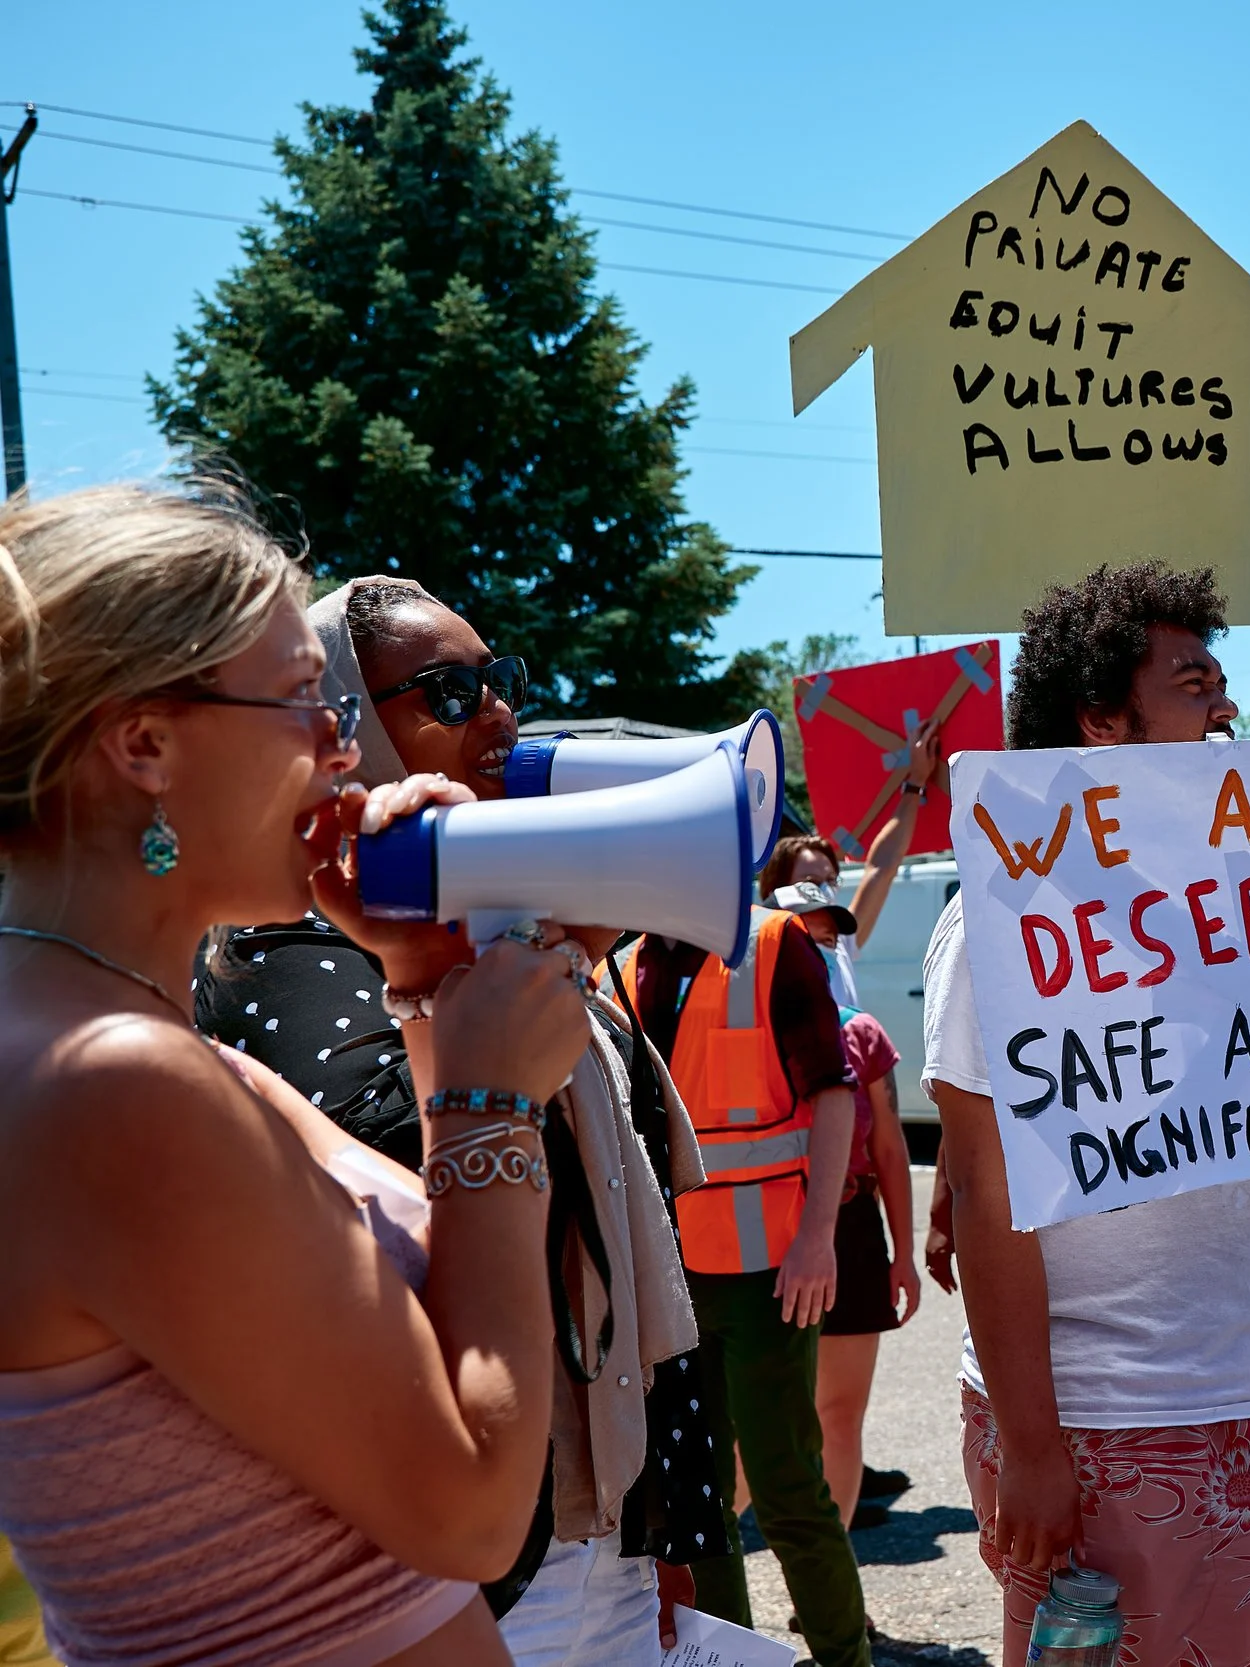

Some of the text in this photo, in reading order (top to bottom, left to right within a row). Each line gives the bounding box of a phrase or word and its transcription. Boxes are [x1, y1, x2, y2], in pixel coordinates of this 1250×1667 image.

[1029, 167, 1131, 227] NO
[973, 784, 1131, 881] WE
[1006, 1014, 1174, 1120] SAFE
